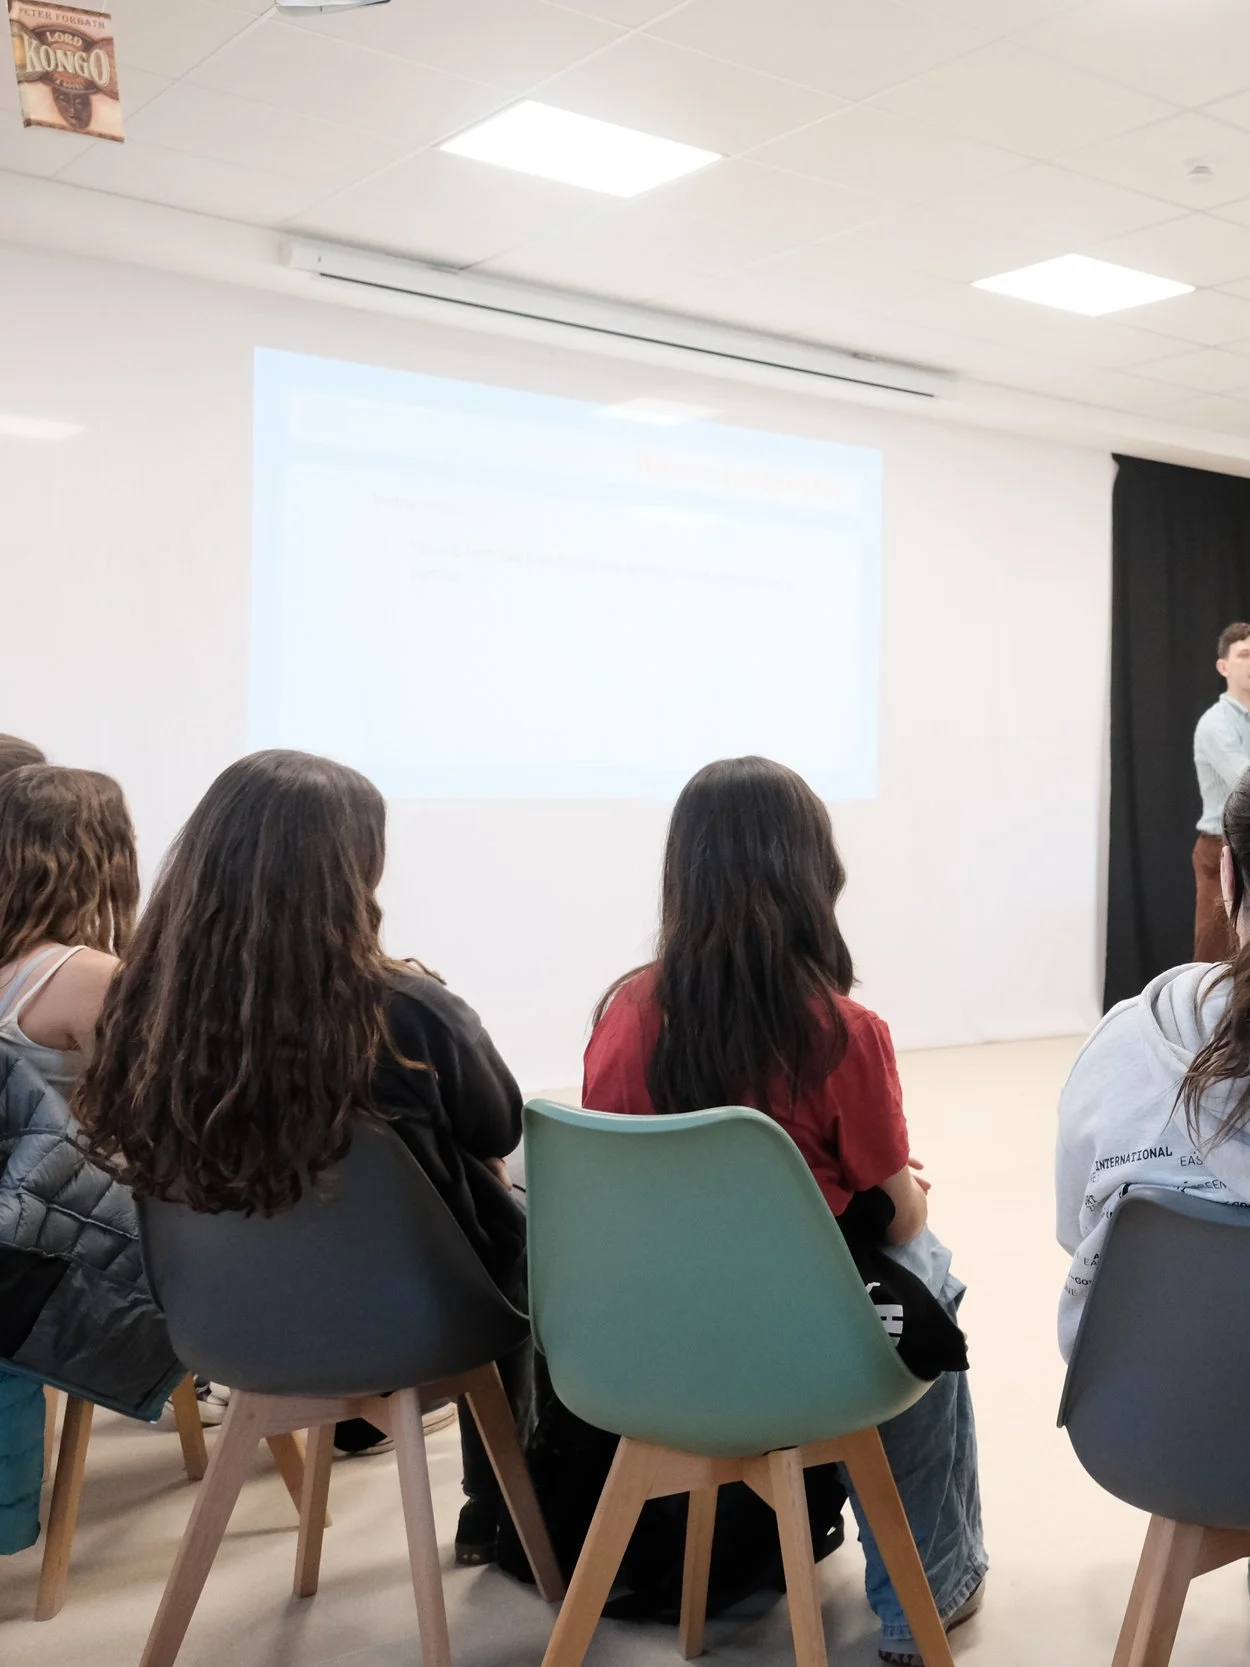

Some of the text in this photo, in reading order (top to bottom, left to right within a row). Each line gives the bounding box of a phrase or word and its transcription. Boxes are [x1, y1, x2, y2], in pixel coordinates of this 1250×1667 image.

[20, 7, 105, 29] PETER FORBATH
[46, 31, 82, 46] LORD
[23, 35, 110, 87] KONGO
[1095, 1146, 1173, 1172] INTERNATIONAL
